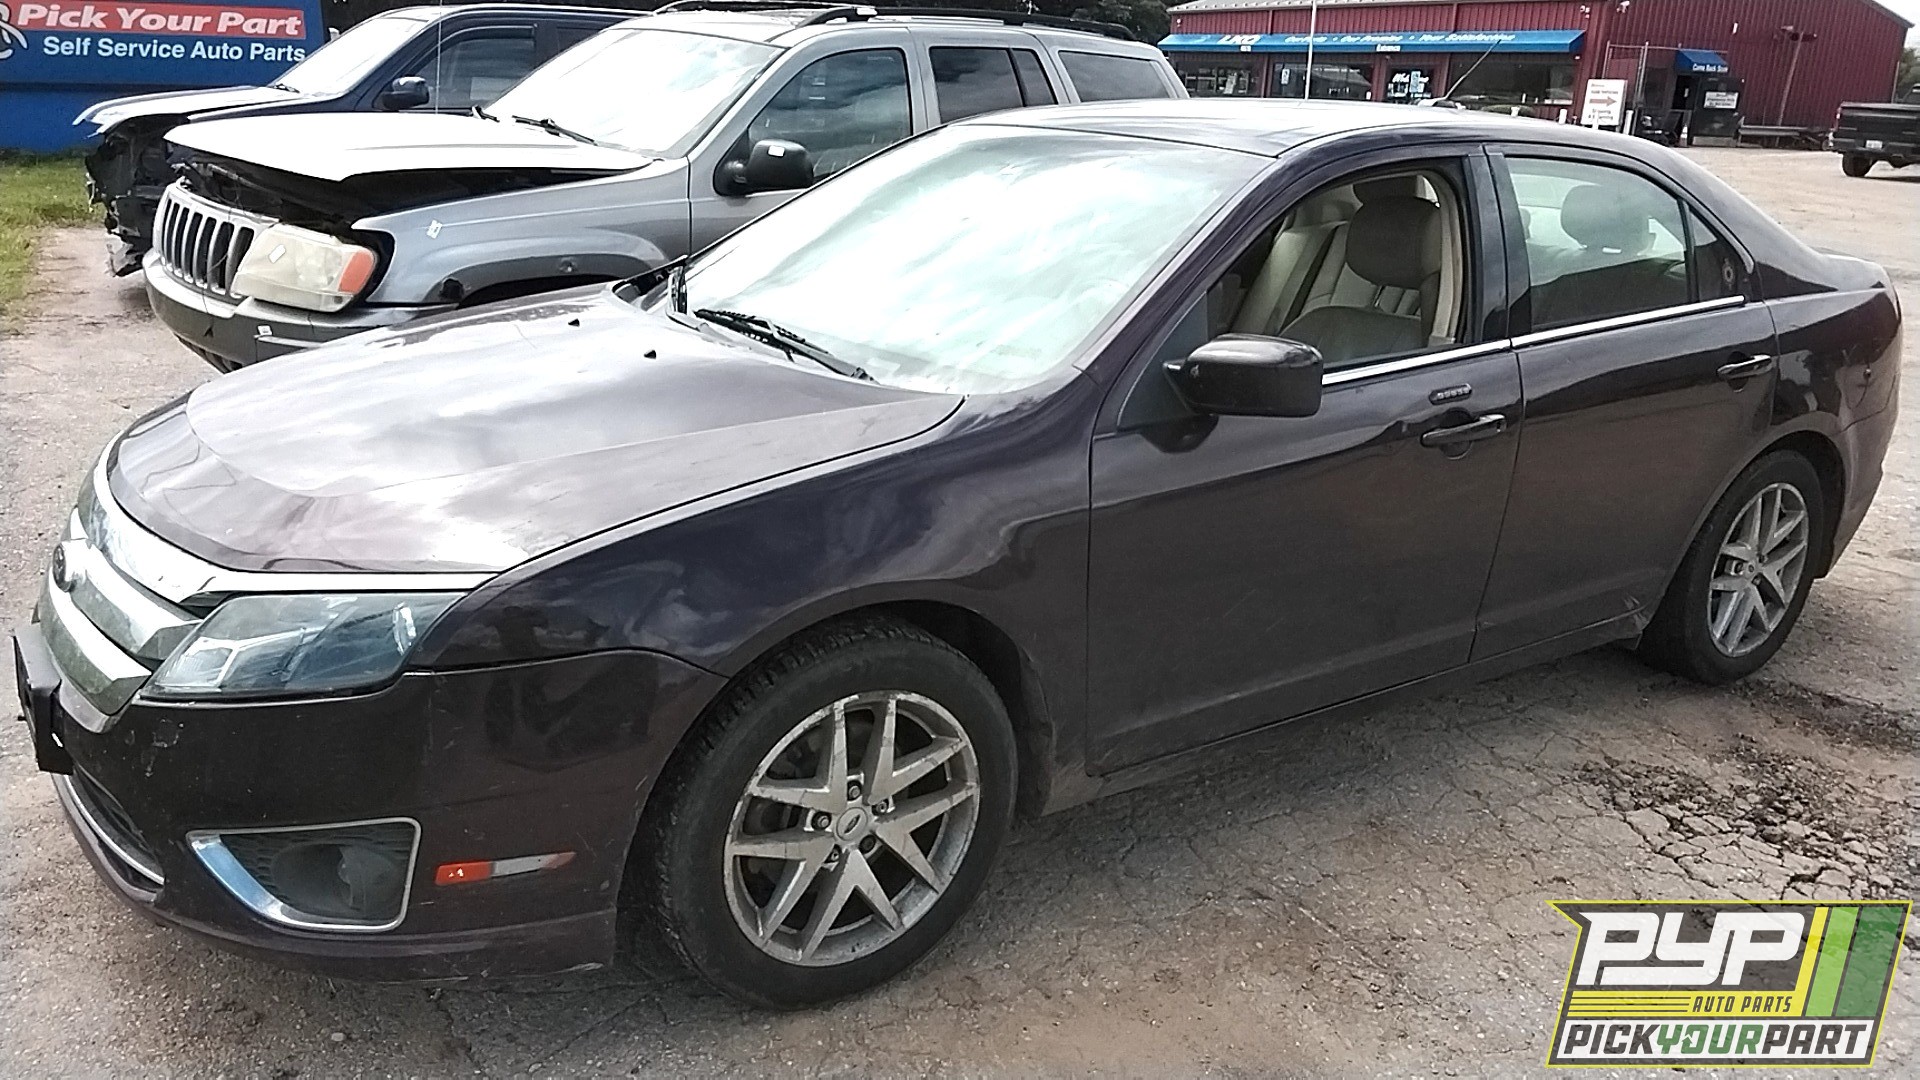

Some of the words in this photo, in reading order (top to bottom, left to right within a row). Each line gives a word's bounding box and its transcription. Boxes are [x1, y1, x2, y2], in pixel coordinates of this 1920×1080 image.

[17, 4, 109, 29] Pick
[117, 7, 212, 33] Your
[216, 11, 303, 36] Part
[43, 35, 91, 56] Self
[98, 38, 185, 59] Service
[190, 41, 243, 61] Auto
[250, 42, 306, 62] Parts
[1216, 34, 1261, 45] LKQ
